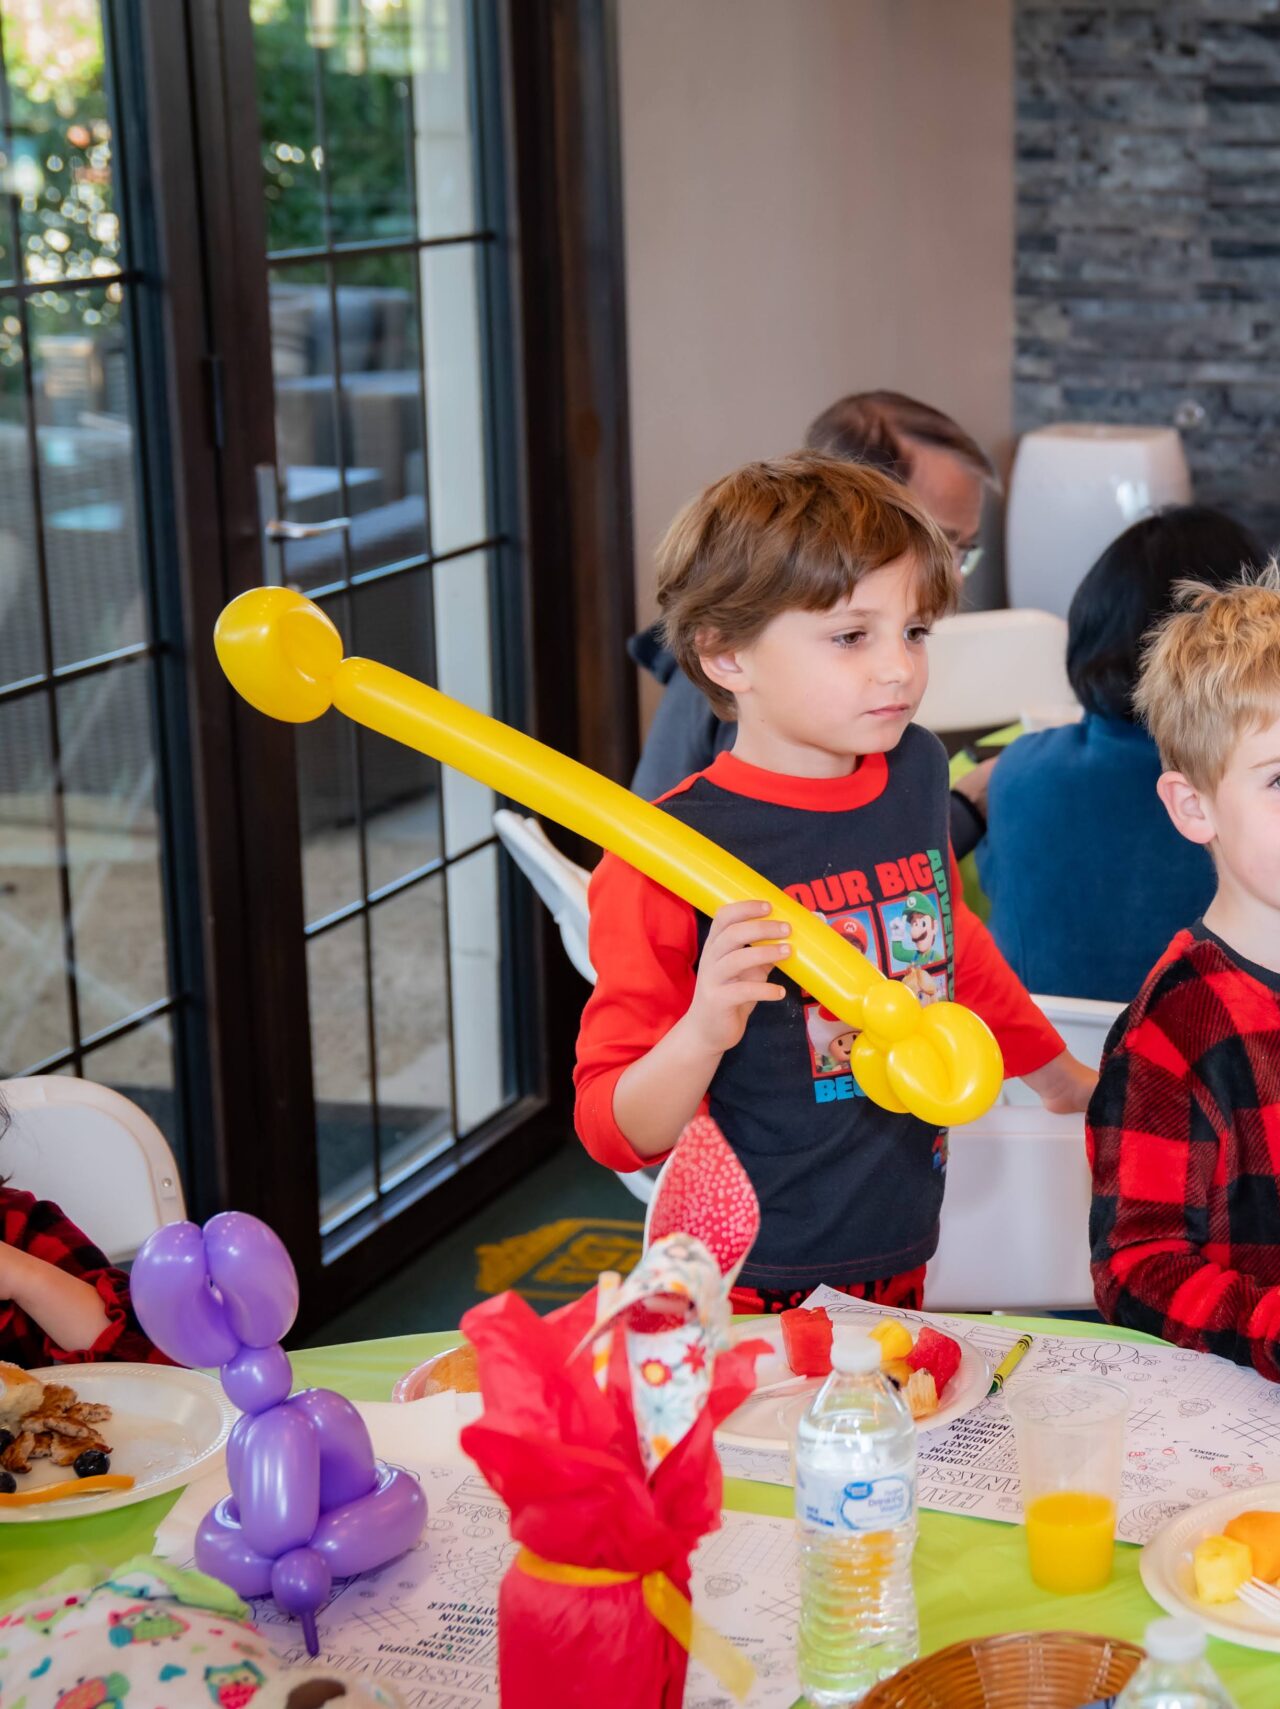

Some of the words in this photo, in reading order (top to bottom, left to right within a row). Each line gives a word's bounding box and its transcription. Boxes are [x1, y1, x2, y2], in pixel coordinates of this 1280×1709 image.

[874, 853, 934, 897] BIG
[948, 1425, 1003, 1438] PUMPKIN
[953, 1433, 994, 1445] INDIAN
[930, 1446, 979, 1459] PILGRIM
[940, 1440, 985, 1452] TURKEY
[445, 1624, 492, 1637] INDIAN
[431, 1632, 482, 1646] TURKEY
[378, 1643, 465, 1662] CORNUCOPIA
[417, 1639, 475, 1654] PILGRIM
